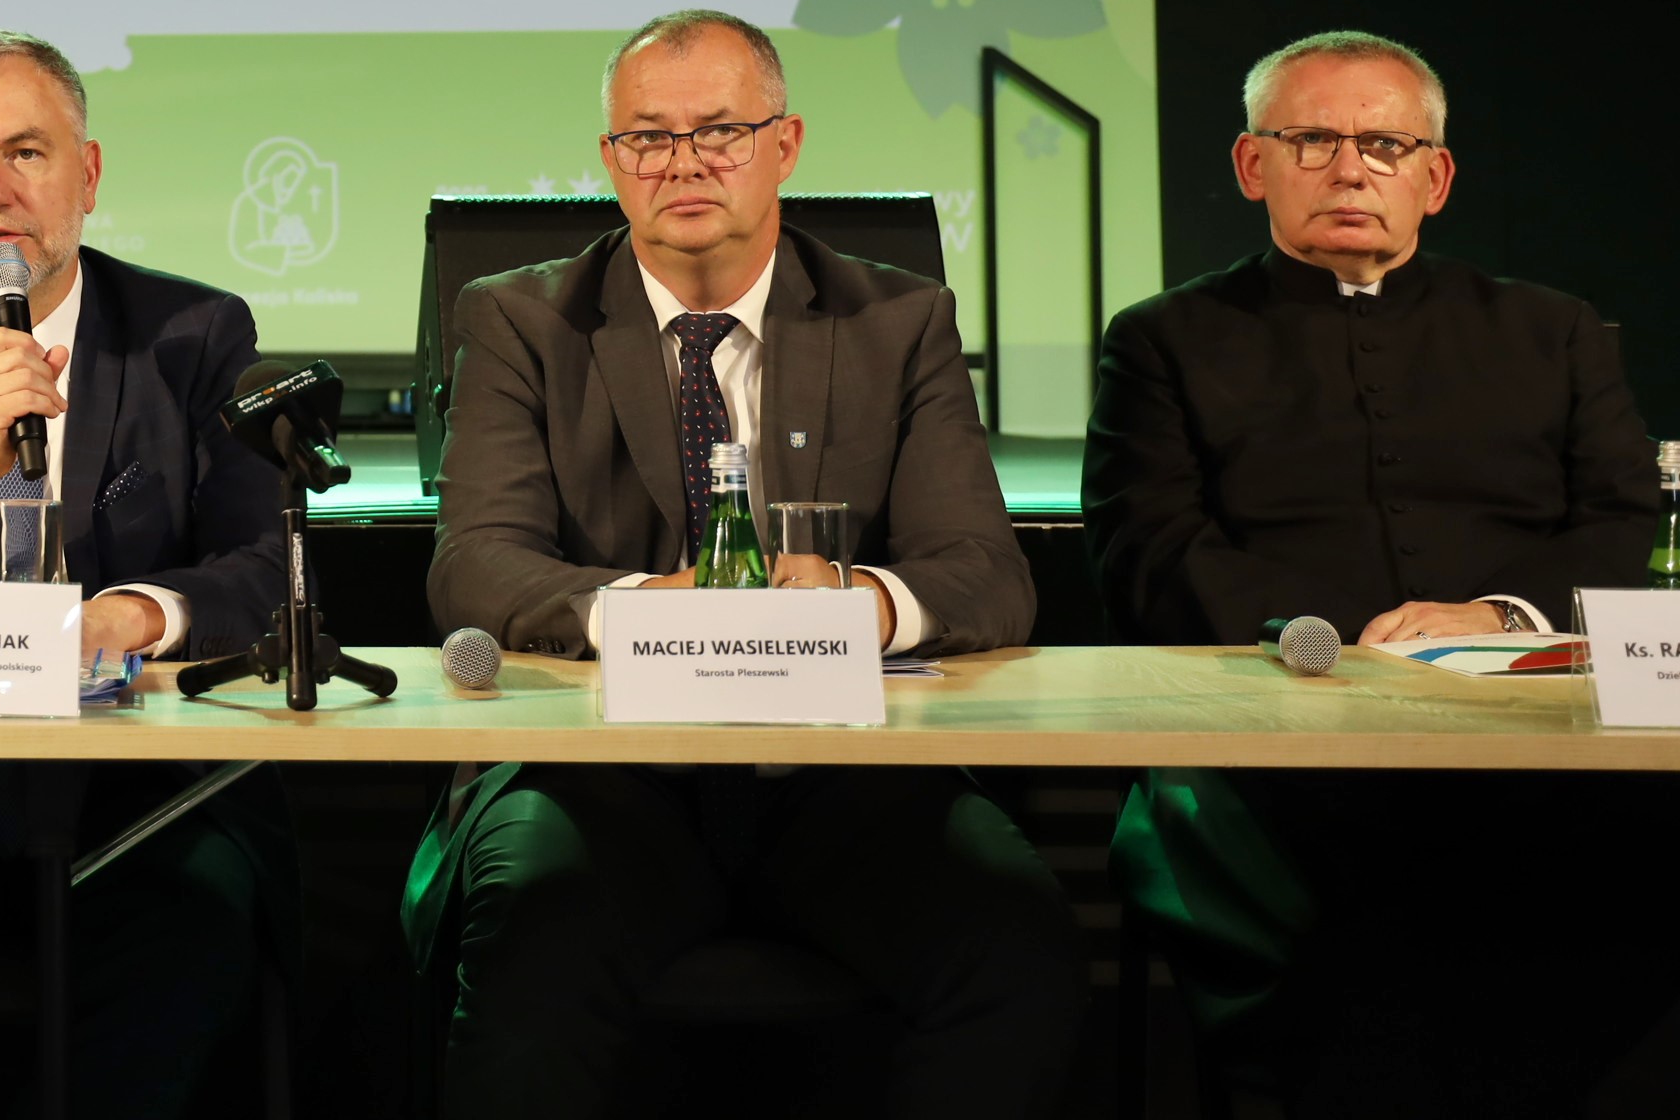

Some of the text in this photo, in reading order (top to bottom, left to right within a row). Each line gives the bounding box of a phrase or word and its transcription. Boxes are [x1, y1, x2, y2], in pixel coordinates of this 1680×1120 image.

[632, 639, 848, 657] MACIEJ WASIELEWSKI
[1624, 641, 1655, 658] Ks.
[694, 667, 789, 678] Starosta Pleszewski
